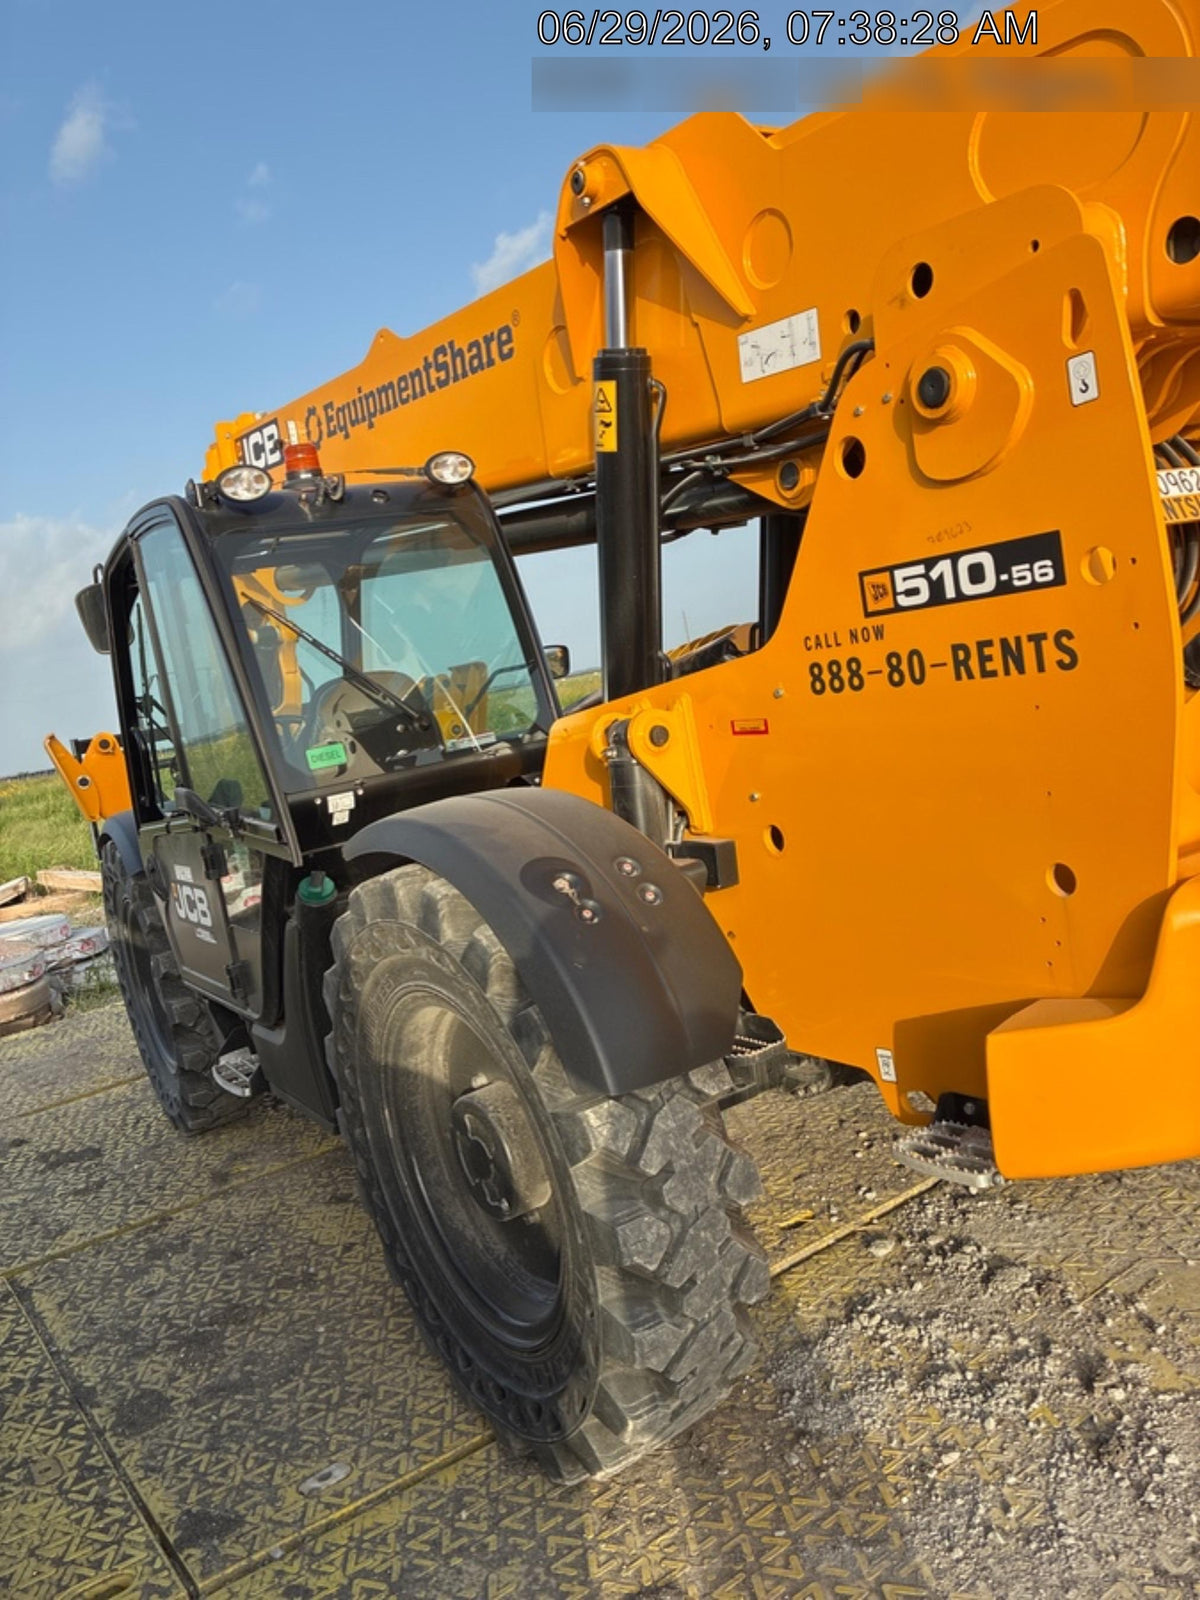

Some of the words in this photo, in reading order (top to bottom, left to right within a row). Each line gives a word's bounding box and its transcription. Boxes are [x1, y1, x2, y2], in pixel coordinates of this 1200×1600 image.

[893, 550, 1055, 607] 510-56
[804, 630, 842, 652] CALL
[849, 623, 886, 645] NOW
[808, 629, 1079, 696] 888-80-RENTS
[310, 749, 342, 764] DIESEL
[175, 883, 213, 928] JCB
